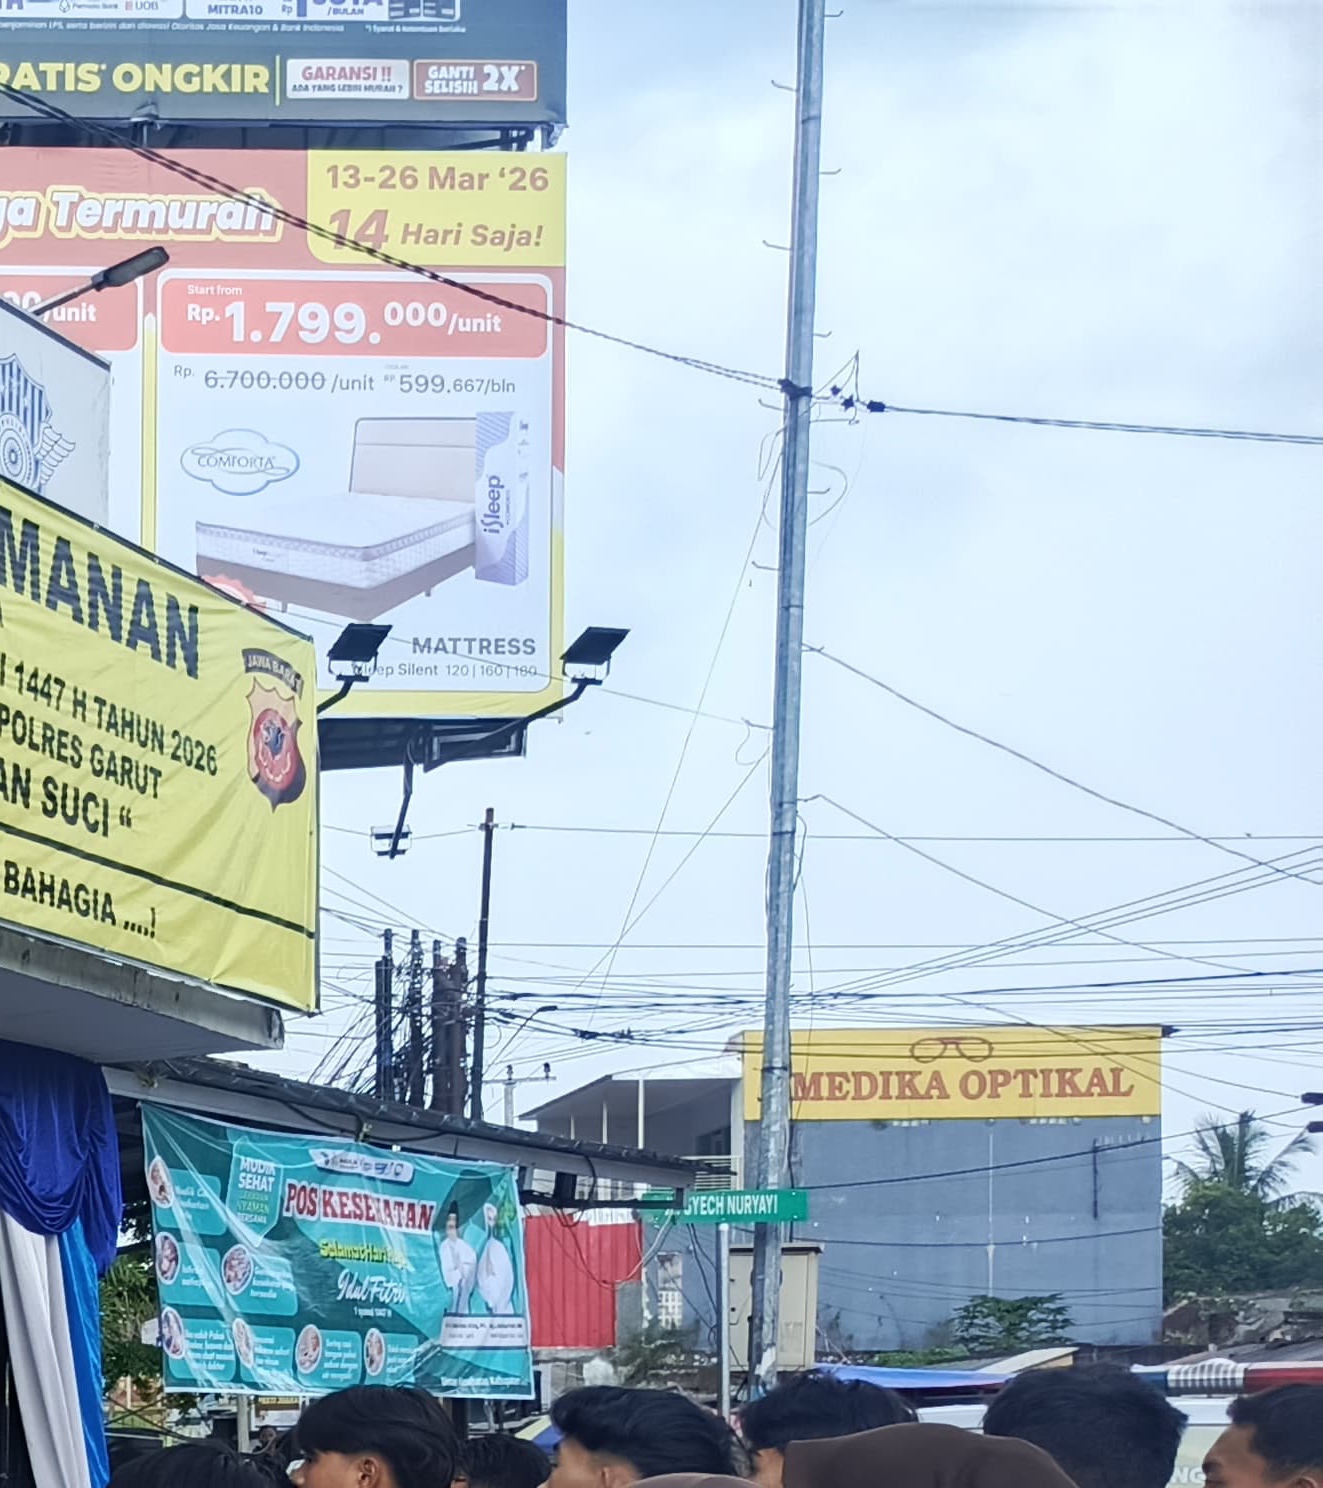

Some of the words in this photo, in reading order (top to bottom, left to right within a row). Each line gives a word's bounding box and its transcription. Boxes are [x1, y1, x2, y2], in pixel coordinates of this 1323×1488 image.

[207, 5, 264, 15] MITRA10
[112, 62, 270, 94] ONGKIR
[301, 66, 377, 82] GARANSI
[427, 65, 475, 80] GANTI
[424, 80, 478, 95] SELISIH
[326, 165, 419, 190] 13-26
[427, 166, 490, 191] Mar
[51, 190, 274, 232] Termurah
[329, 208, 390, 251] 14
[401, 223, 461, 246] Hari
[470, 225, 544, 252] Saja!
[187, 285, 215, 296] Start
[216, 285, 243, 296] from
[204, 370, 327, 390] 6.700.000
[411, 637, 537, 655] MATTRESS
[247, 654, 270, 669] JAWA
[398, 663, 439, 676] Silent
[446, 664, 470, 677] 120
[480, 665, 504, 677] 160
[514, 666, 538, 678] 180
[15, 661, 66, 711] 1447
[72, 686, 88, 723] H
[94, 696, 164, 756] TAHUN
[171, 730, 218, 776] 2026
[90, 743, 163, 799] GARUT
[41, 775, 110, 838] SUCI
[4, 860, 117, 926] BAHAGIA
[792, 1070, 950, 1101] MEDIKA
[958, 1068, 1135, 1100] OPTIKAL
[239, 1156, 276, 1176] MUDIK
[238, 1172, 275, 1193] SEHAT
[284, 1182, 319, 1217] POS
[322, 1189, 435, 1232] KESEHATAN
[727, 1194, 779, 1215] NURYAYI
